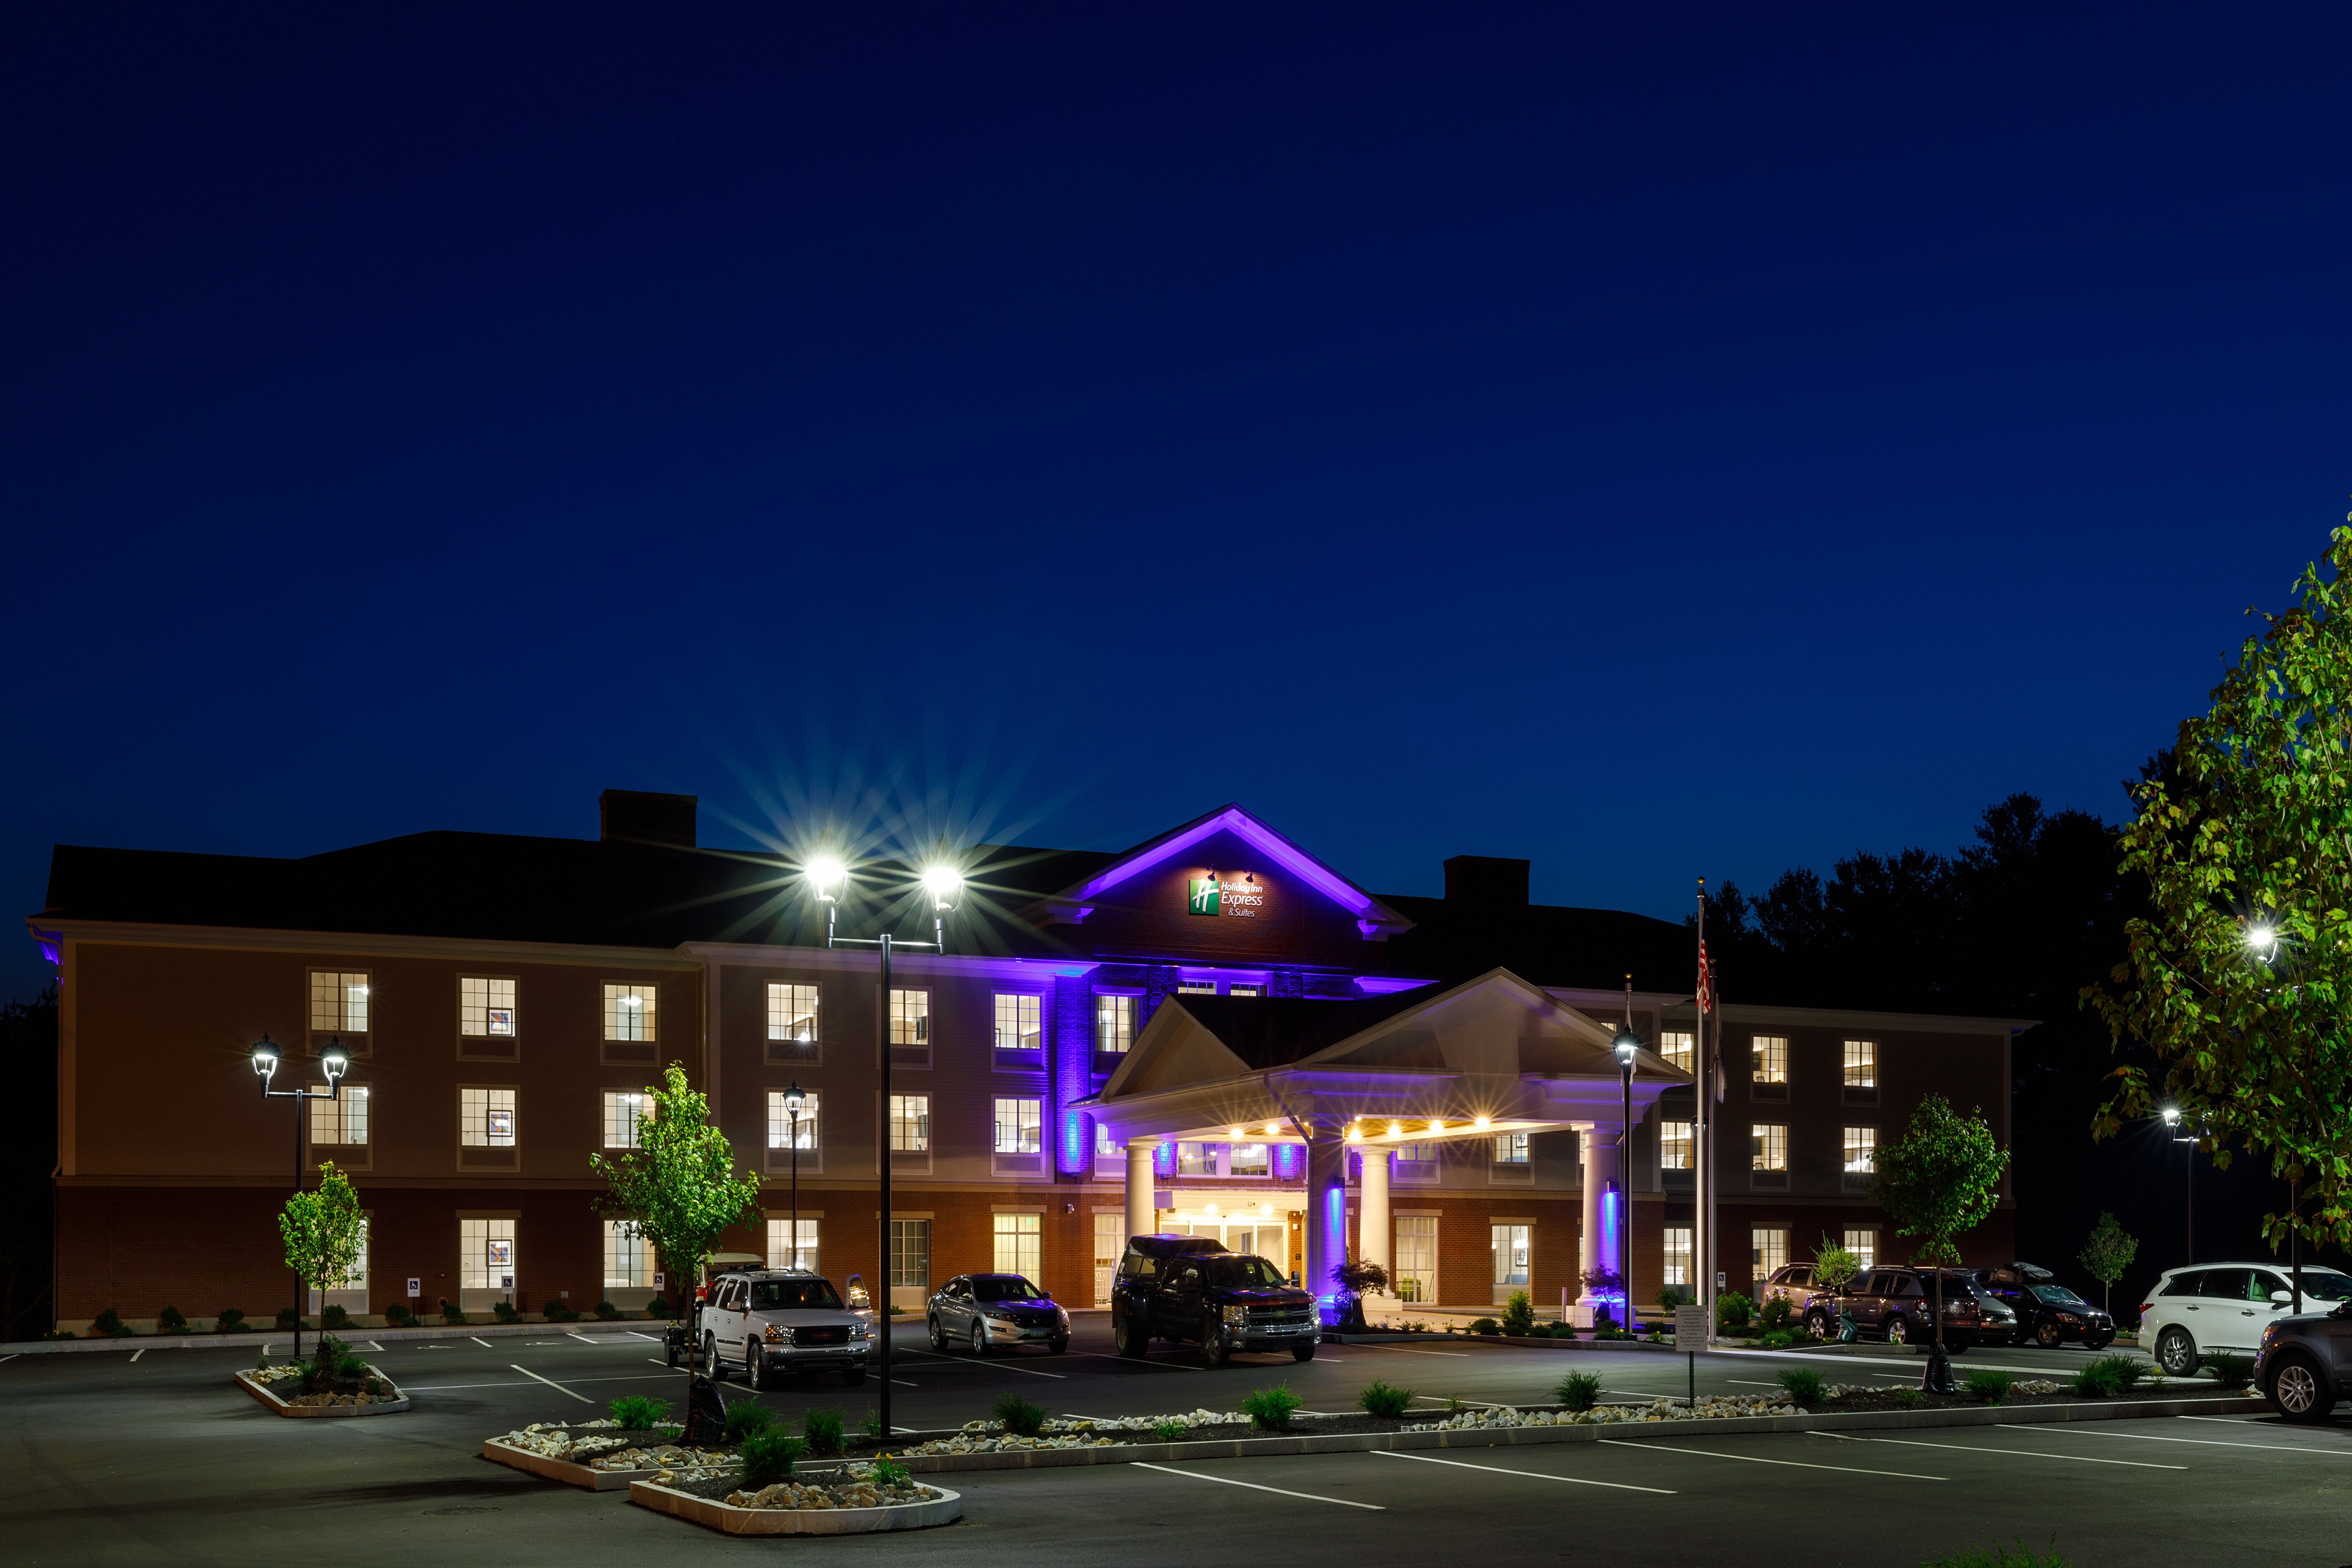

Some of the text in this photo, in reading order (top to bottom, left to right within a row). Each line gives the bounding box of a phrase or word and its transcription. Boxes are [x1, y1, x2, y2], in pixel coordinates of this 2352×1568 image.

[1221, 881, 1263, 894] Holiday Inn
[1193, 881, 1219, 912] H
[1221, 892, 1263, 907] Express
[1228, 908, 1255, 917] & Suites
